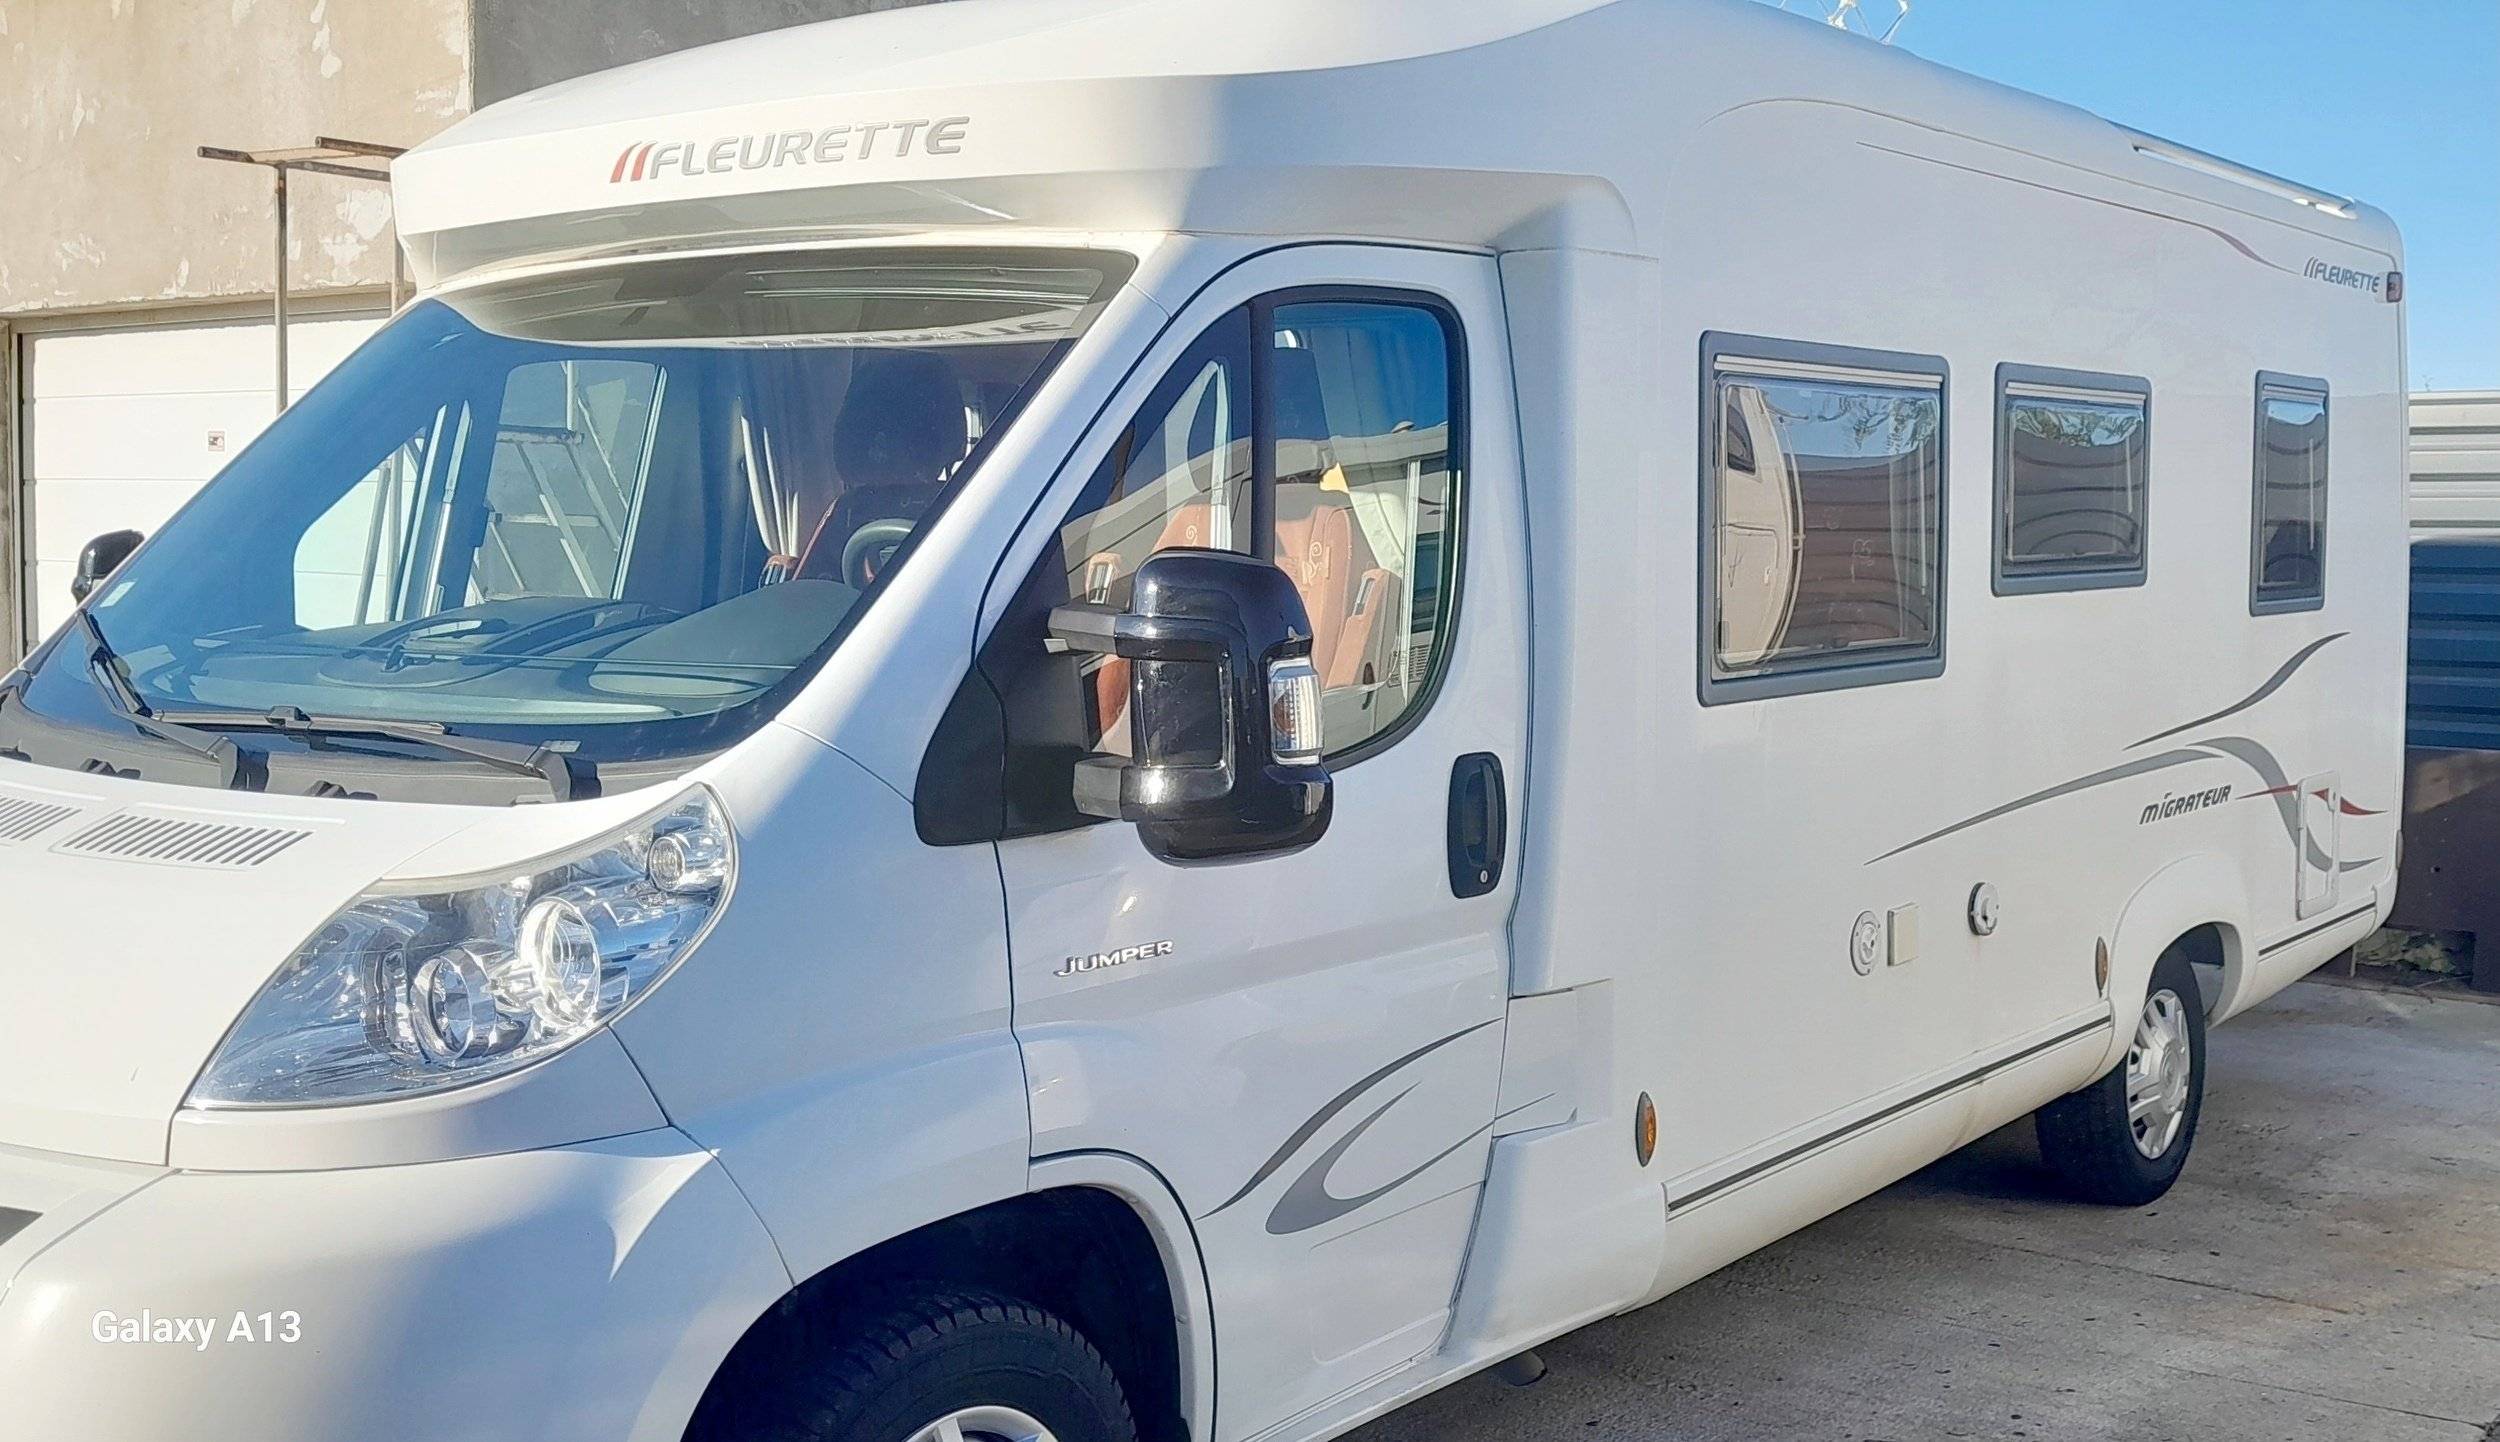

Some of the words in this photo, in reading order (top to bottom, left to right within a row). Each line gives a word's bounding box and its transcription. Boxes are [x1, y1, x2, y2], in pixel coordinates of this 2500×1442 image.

[649, 115, 970, 180] FLEURETTE
[2313, 261, 2381, 293] FLEURETTE
[1053, 940, 1175, 977] JUMPER
